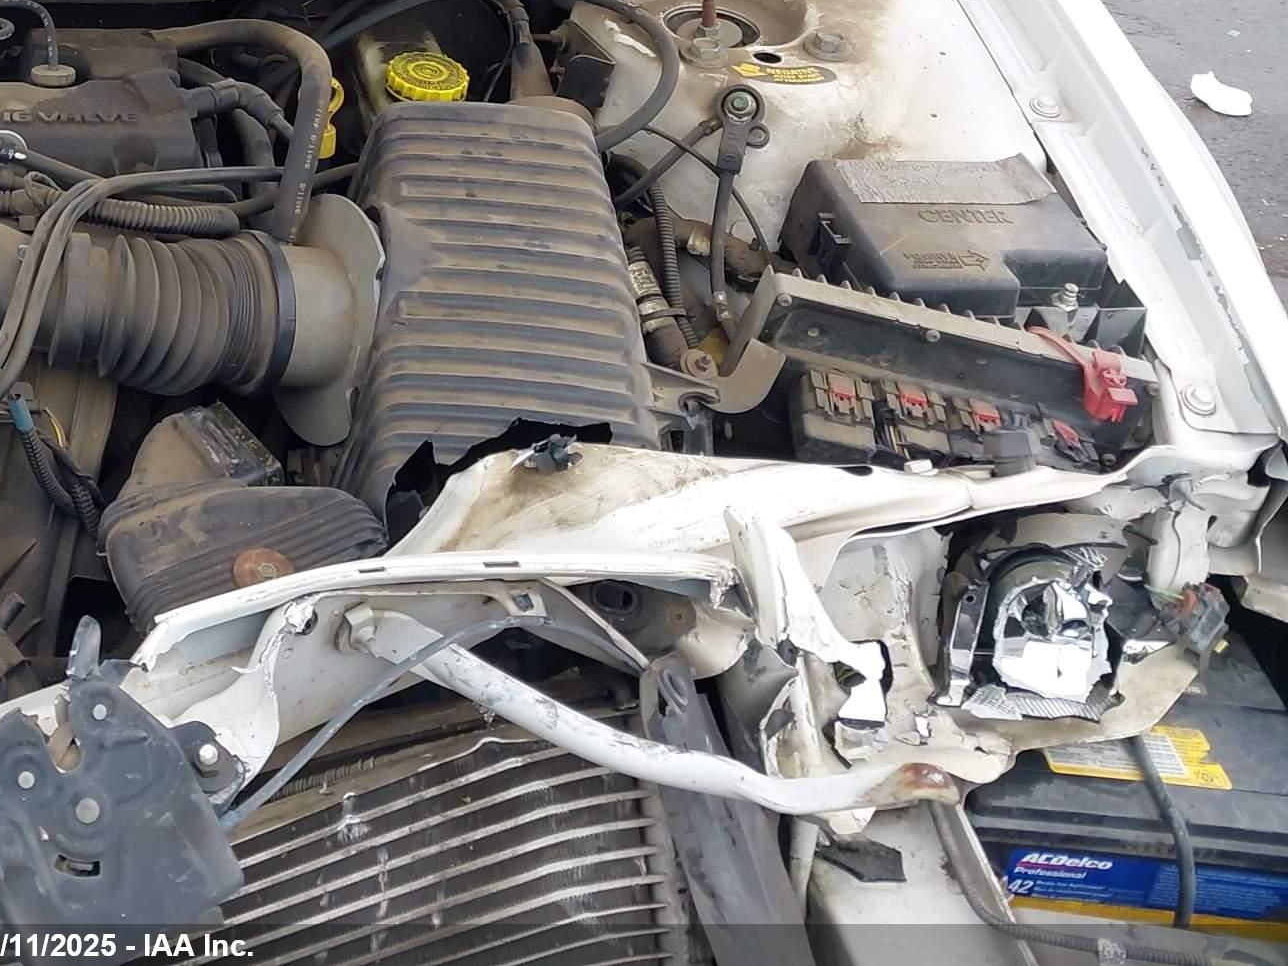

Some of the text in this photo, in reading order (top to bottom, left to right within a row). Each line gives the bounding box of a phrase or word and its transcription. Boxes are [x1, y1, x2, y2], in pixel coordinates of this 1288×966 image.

[766, 67, 820, 75] NEGATIVE
[2, 111, 31, 122] 16
[37, 111, 138, 123] VALVE
[917, 209, 1014, 224] CENTER
[1020, 852, 1113, 870] ACDelco
[1013, 866, 1088, 879] Professional
[1007, 879, 1034, 894] 42
